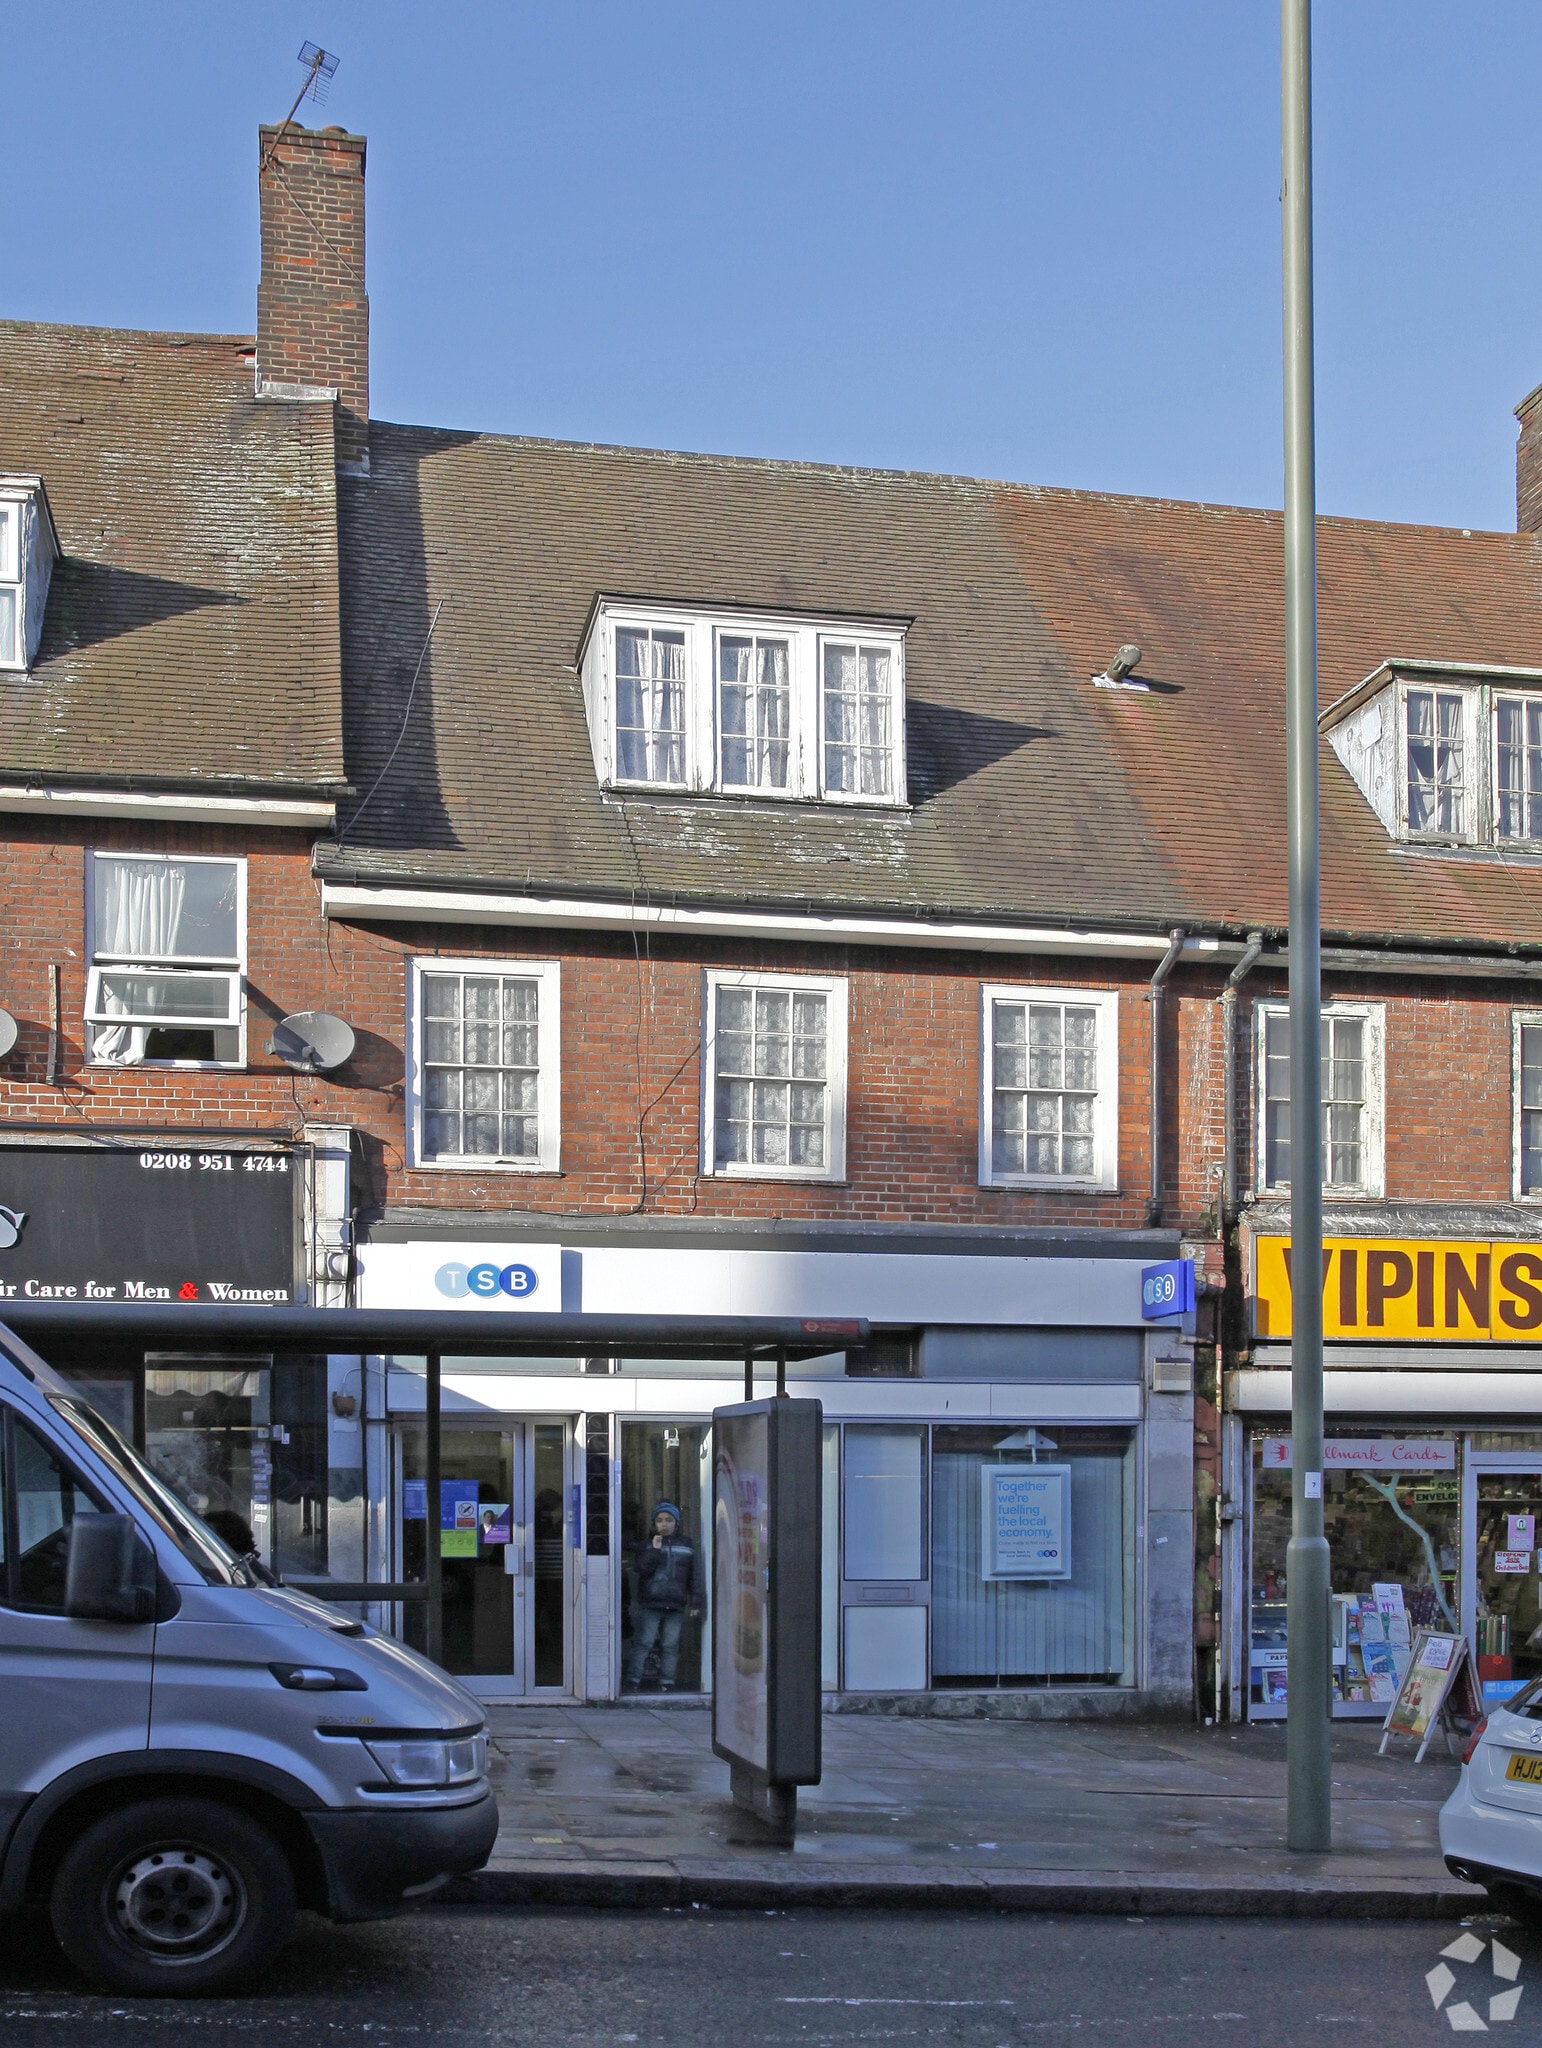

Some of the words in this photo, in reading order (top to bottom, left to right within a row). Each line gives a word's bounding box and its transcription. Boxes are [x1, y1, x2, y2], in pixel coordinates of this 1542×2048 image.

[140, 1153, 192, 1170] 0208
[199, 1154, 234, 1171] 951
[242, 1155, 289, 1172] 4744
[444, 1269, 529, 1292] TSB
[24, 1279, 77, 1298] Care
[84, 1280, 116, 1298] for
[123, 1281, 170, 1299] Men
[178, 1281, 199, 1300] &
[207, 1282, 289, 1301] Women
[1282, 1247, 1542, 1330] IPINS
[1323, 1444, 1384, 1462] llmark
[1391, 1445, 1447, 1461] Cards
[996, 1481, 1048, 1493] Together
[998, 1493, 1029, 1503] we're
[998, 1505, 1040, 1516] fuelling
[998, 1516, 1017, 1526] the
[1019, 1516, 1047, 1526] local
[998, 1528, 1054, 1538] economy.
